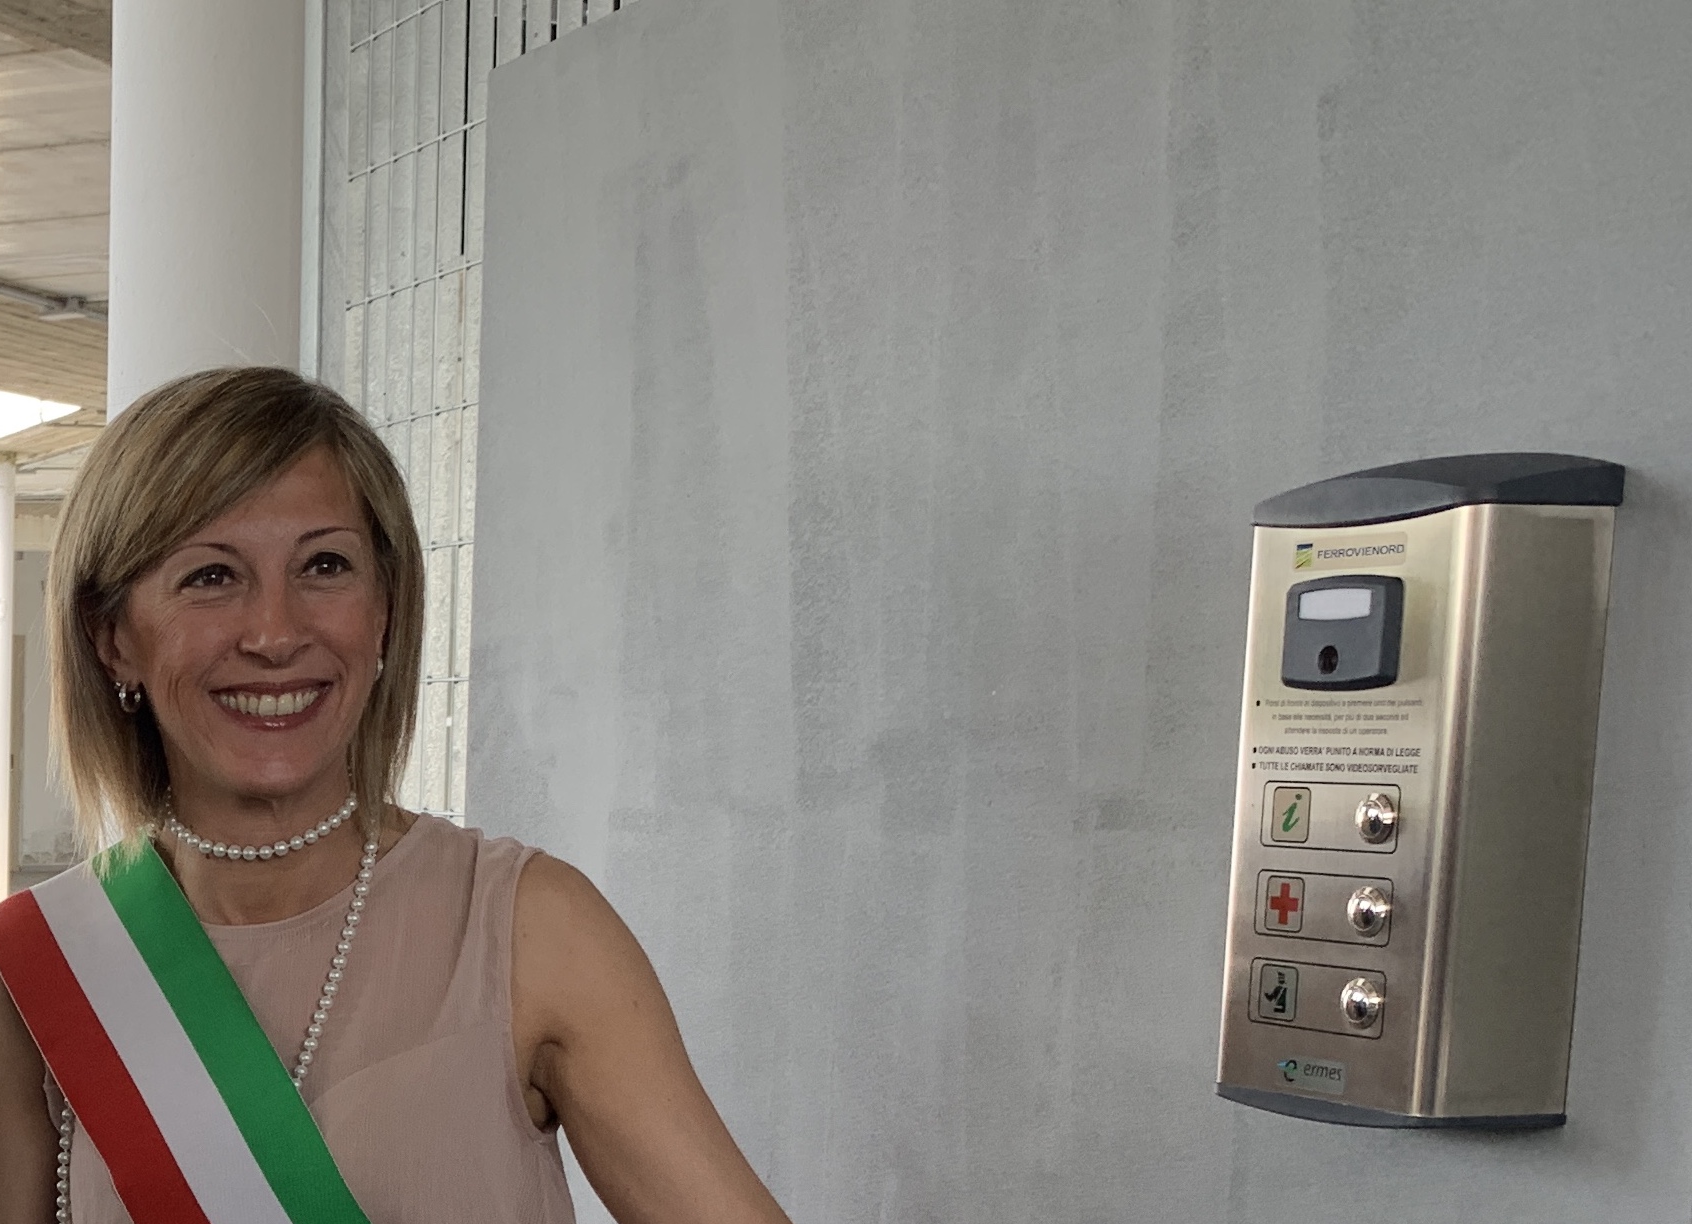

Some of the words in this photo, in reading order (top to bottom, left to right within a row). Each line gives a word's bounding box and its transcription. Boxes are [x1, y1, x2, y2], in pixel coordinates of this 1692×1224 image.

[1317, 544, 1405, 559] FERROVIENORD
[1258, 746, 1274, 755] OGNI
[1275, 746, 1299, 755] ABUSO
[1326, 747, 1351, 756] PUNITO
[1352, 747, 1357, 756] A
[1359, 747, 1385, 757] NORMA
[1386, 748, 1394, 757] DI
[1395, 748, 1421, 758] LEGGE
[1259, 761, 1279, 771] TUTTE
[1280, 762, 1289, 771] LE
[1290, 762, 1324, 772] CHIAMATE
[1326, 763, 1346, 773] SONO
[1347, 763, 1419, 775] VIDEOSORVEGLIATE
[1303, 1063, 1343, 1081] ermes
